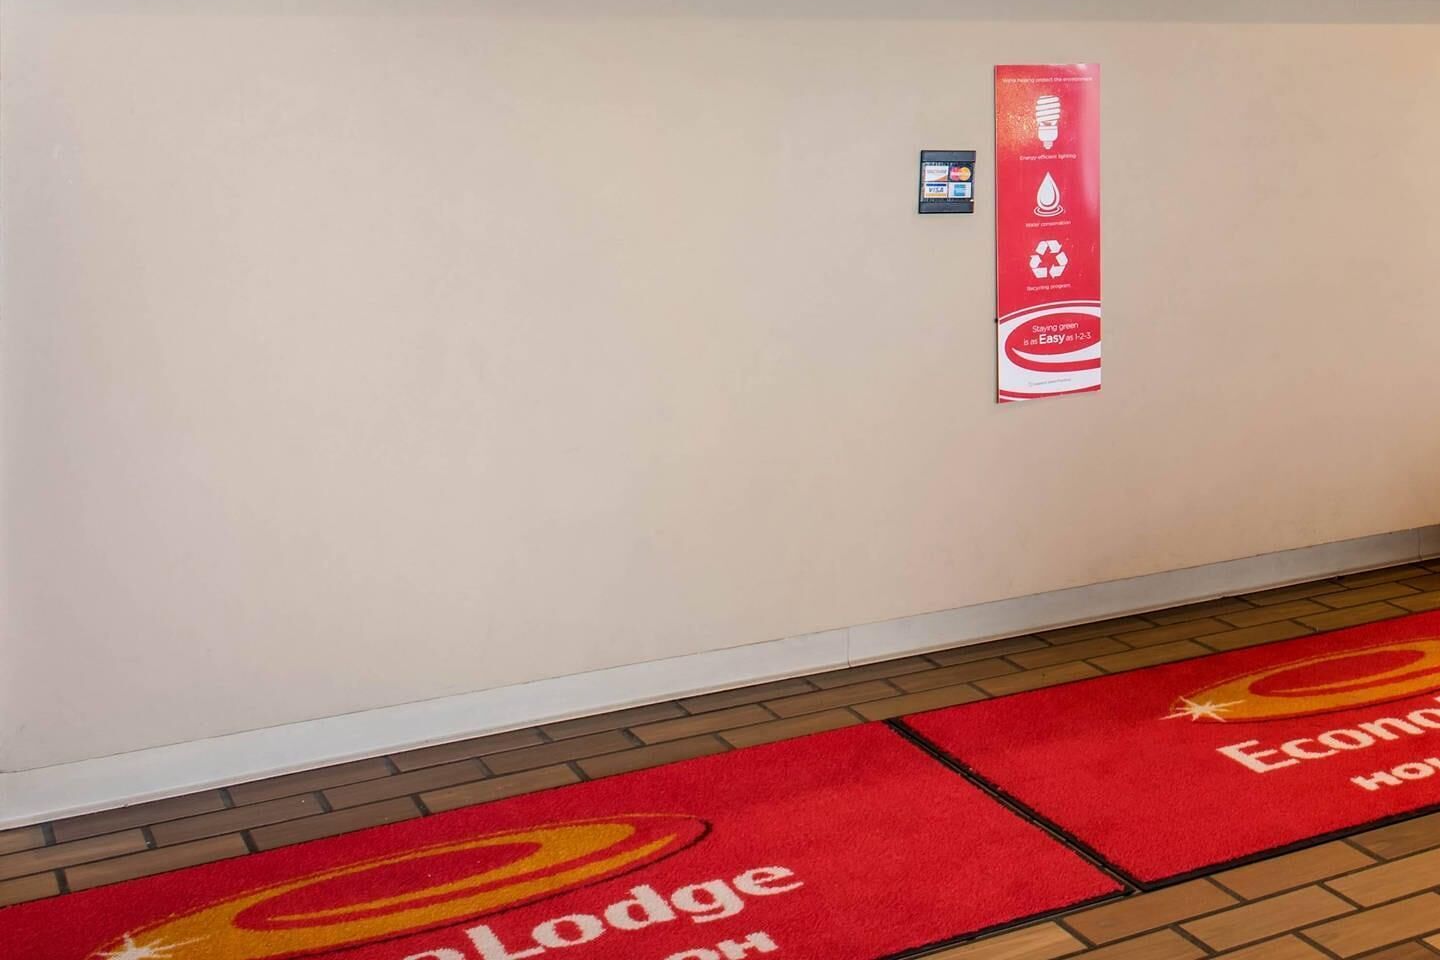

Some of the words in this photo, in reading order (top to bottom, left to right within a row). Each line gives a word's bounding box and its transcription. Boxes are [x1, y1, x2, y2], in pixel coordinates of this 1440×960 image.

[1032, 324, 1058, 333] Staying
[1058, 322, 1079, 331] green
[1039, 333, 1066, 344] Easy
